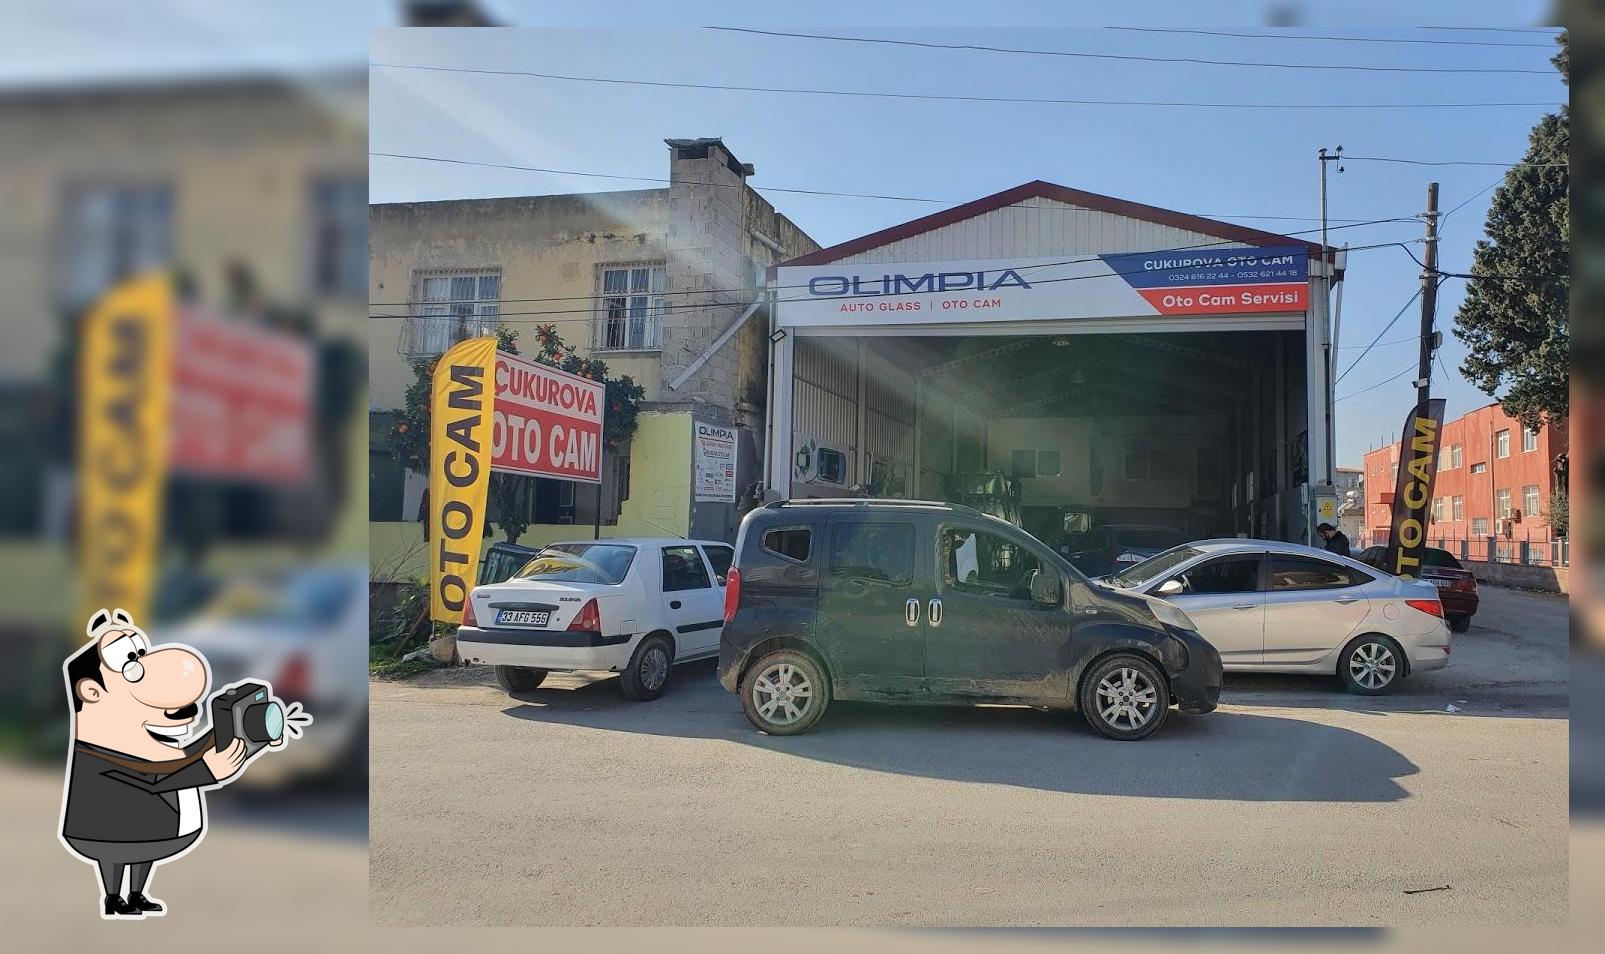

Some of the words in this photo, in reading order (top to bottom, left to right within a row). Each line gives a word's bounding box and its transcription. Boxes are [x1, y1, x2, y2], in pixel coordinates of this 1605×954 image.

[808, 270, 1032, 296] OLIMPIA
[1227, 255, 1258, 267] OTO
[1261, 255, 1293, 266] CAM
[840, 302, 875, 313] AUTO
[879, 301, 922, 312] GLASS
[942, 299, 968, 311] OTO
[973, 298, 1002, 309] CAM
[1162, 294, 1194, 308] Oto
[1198, 293, 1236, 307] Cam
[1241, 291, 1299, 305] Servisi
[494, 360, 597, 416] ÇUKUROVA
[443, 364, 485, 488] CAM
[491, 410, 542, 464] OTO
[549, 424, 597, 473] CAM
[1403, 416, 1438, 510] CAM
[439, 500, 473, 613] OTO
[1396, 518, 1423, 580] TO
[502, 611, 514, 622] 33
[514, 612, 530, 623] AFG
[531, 613, 548, 624] 556
